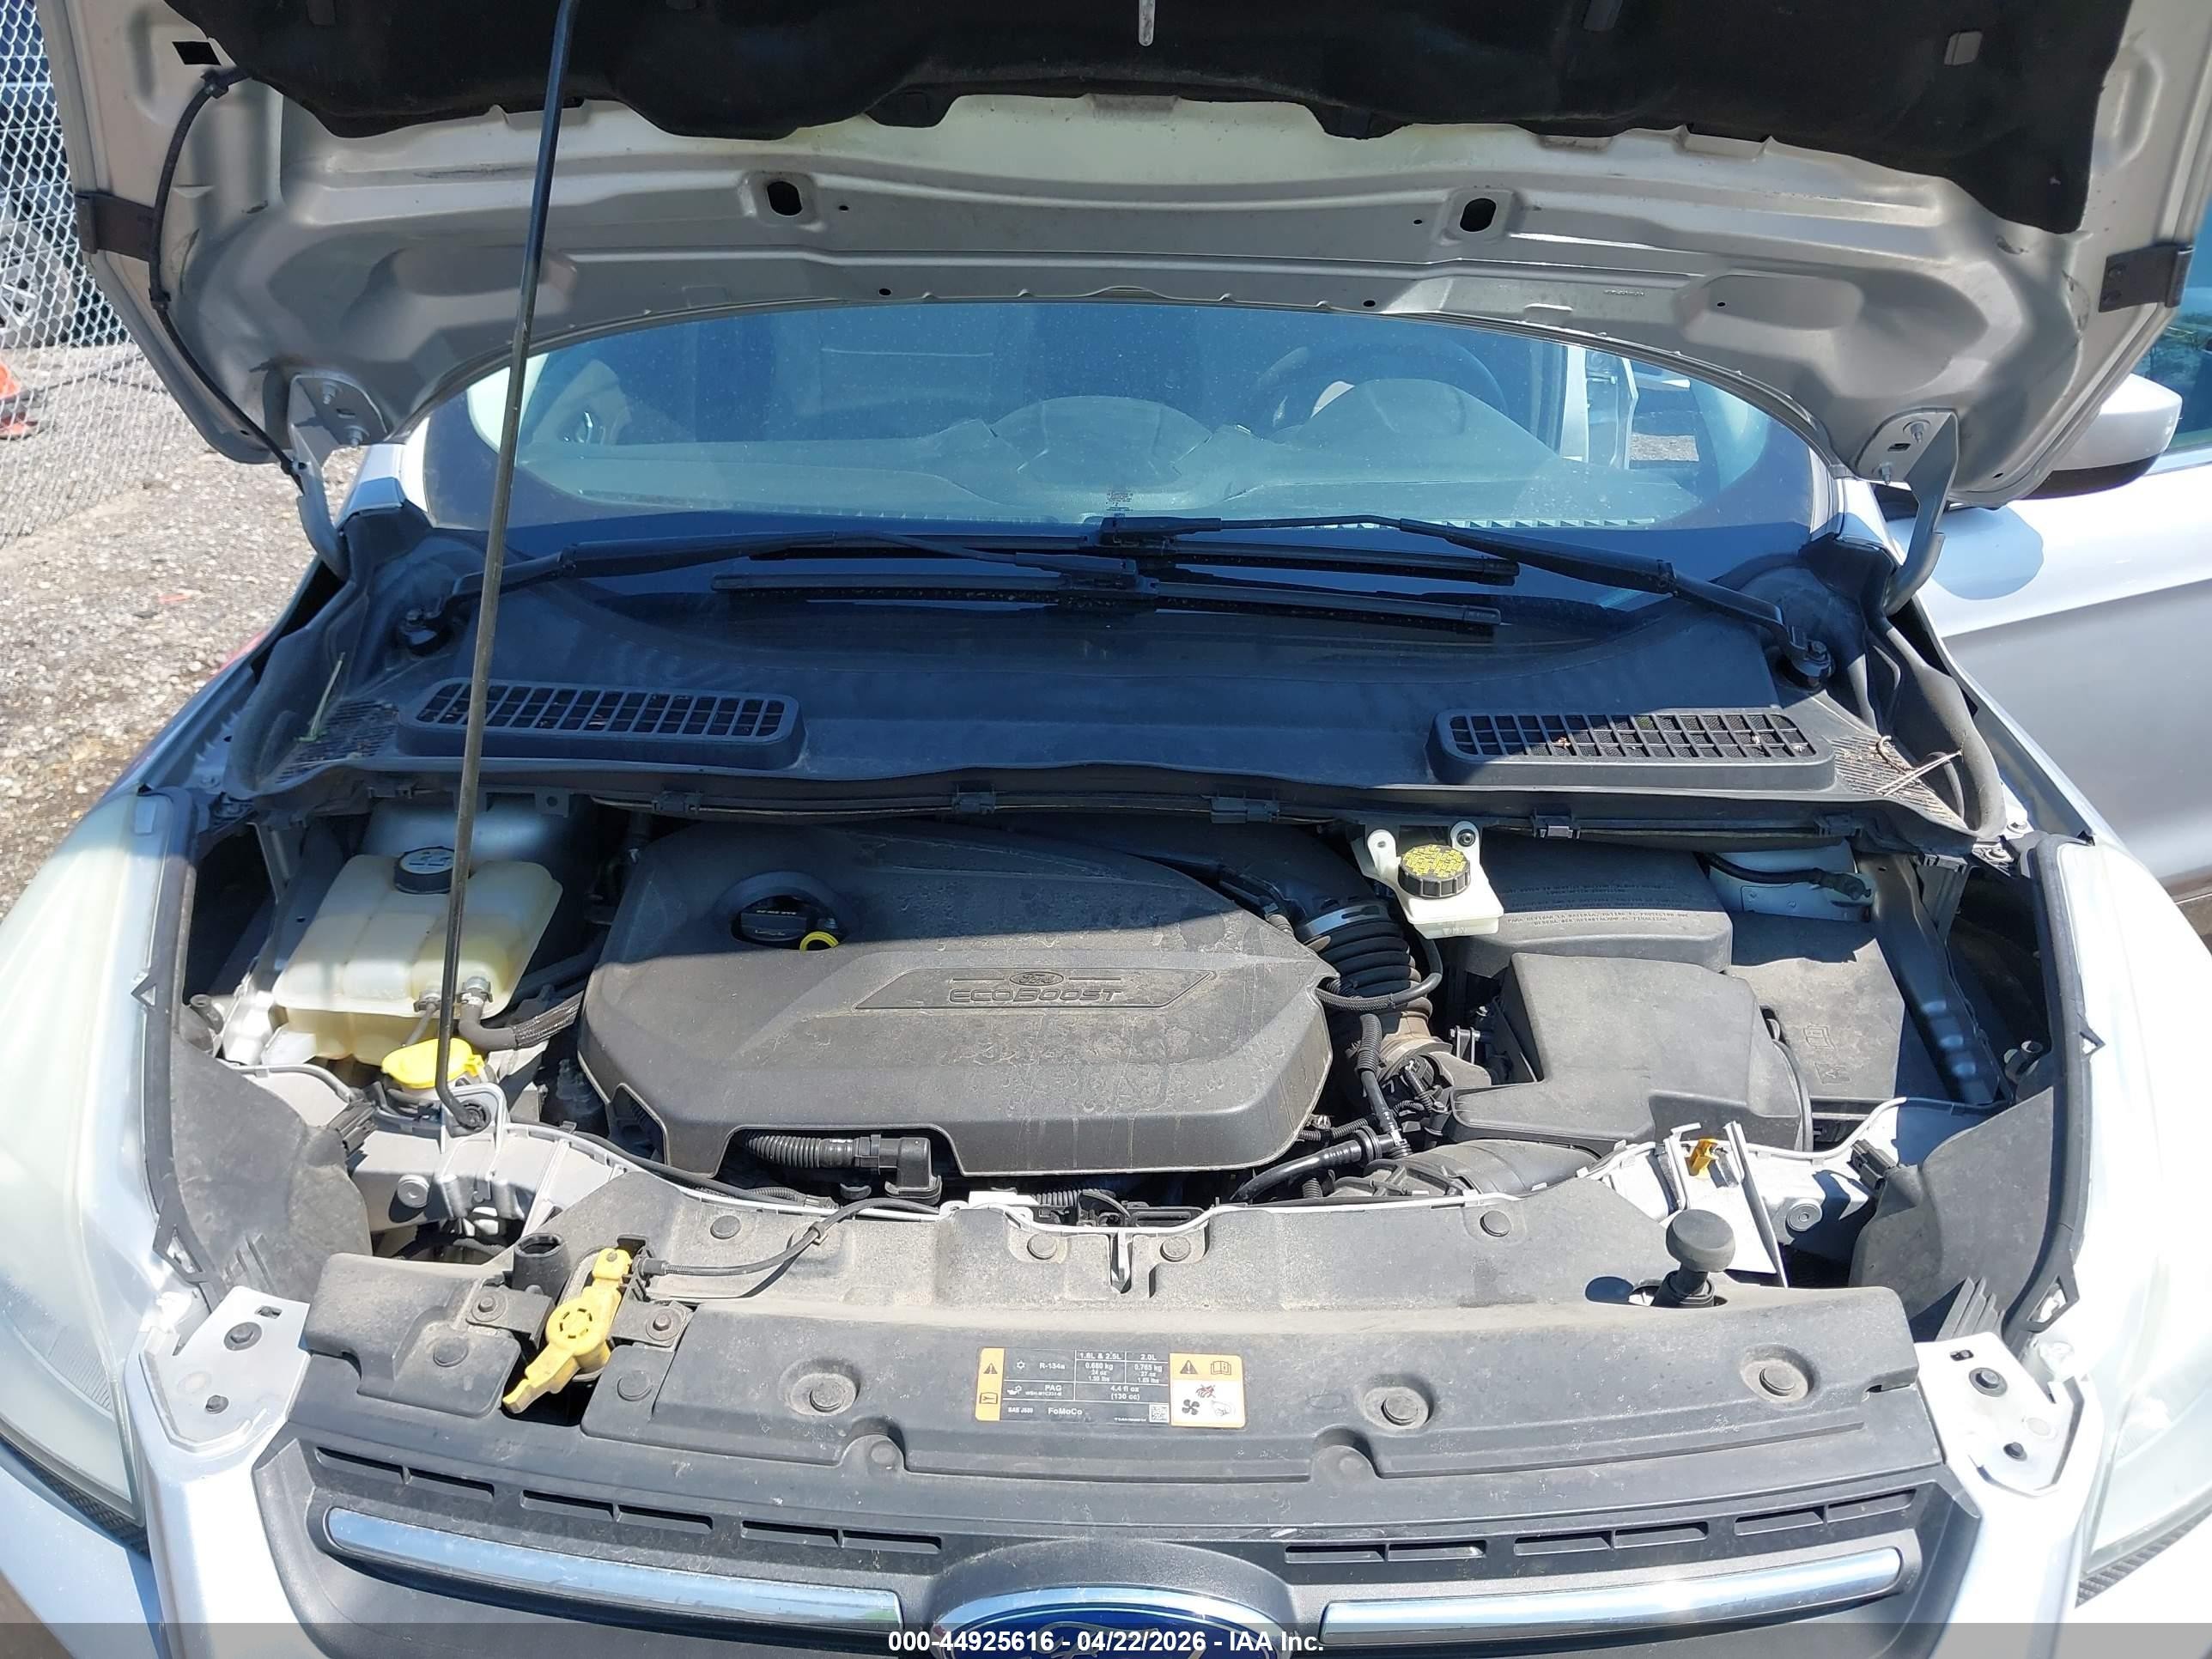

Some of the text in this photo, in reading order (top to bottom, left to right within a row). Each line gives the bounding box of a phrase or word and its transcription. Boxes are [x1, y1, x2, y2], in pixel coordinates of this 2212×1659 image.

[950, 988, 1121, 1003] ECOBOOST
[1104, 1362, 1114, 1371] kg
[1128, 1393, 1140, 1401] cc)
[1048, 1407, 1084, 1415] FoMoCo
